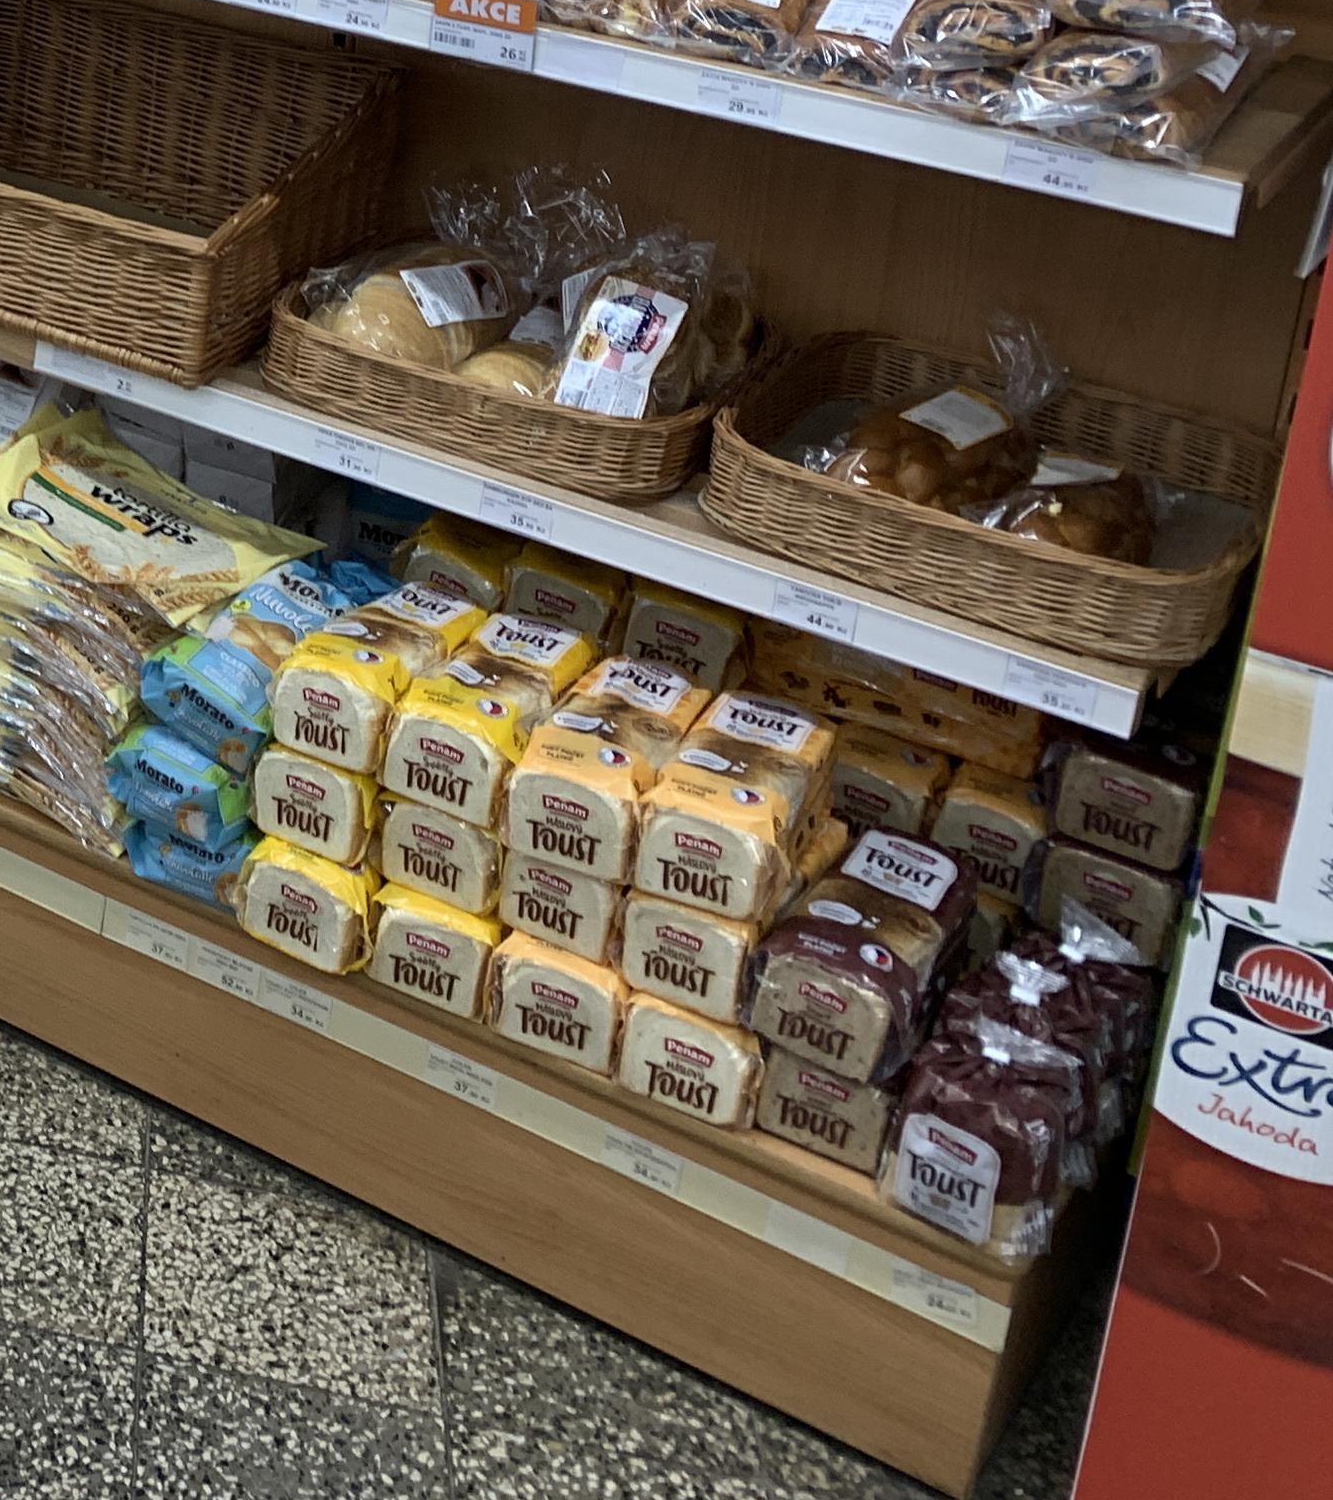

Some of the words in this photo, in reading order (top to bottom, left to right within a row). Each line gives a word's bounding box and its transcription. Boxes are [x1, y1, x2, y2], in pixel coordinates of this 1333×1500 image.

[90, 486, 198, 547] wraps
[358, 520, 400, 545] Mor
[248, 582, 310, 634] Nuvol
[401, 590, 457, 615] OUST
[181, 683, 235, 732] Morato
[302, 687, 341, 711] Penam
[294, 715, 350, 756] TOUST
[420, 737, 464, 764] Penam
[135, 759, 184, 796] Morato
[286, 775, 325, 800] Penam
[404, 760, 473, 806] TOUST
[271, 800, 334, 844] TOUST
[543, 796, 589, 821] Penam
[412, 823, 454, 850] Penam
[526, 819, 600, 866] TOUST
[675, 832, 723, 858] Penam
[397, 845, 461, 892] TOUST
[529, 868, 572, 894] Penam
[658, 859, 733, 907] TOUST
[281, 883, 318, 912] Pena
[512, 890, 583, 939] TOUST
[266, 905, 318, 950] TOUS
[406, 932, 452, 959] Penam
[655, 925, 703, 952] Penam
[389, 954, 461, 1002] TOUST
[532, 983, 579, 1008] Penam
[798, 980, 847, 1014] Penam
[1223, 973, 1333, 1028] SCHWARTA
[517, 1006, 592, 1050] TOUST
[665, 1038, 714, 1066] Penam
[1171, 1016, 1333, 1118] Extr
[1197, 1094, 1319, 1157] Jahoda
